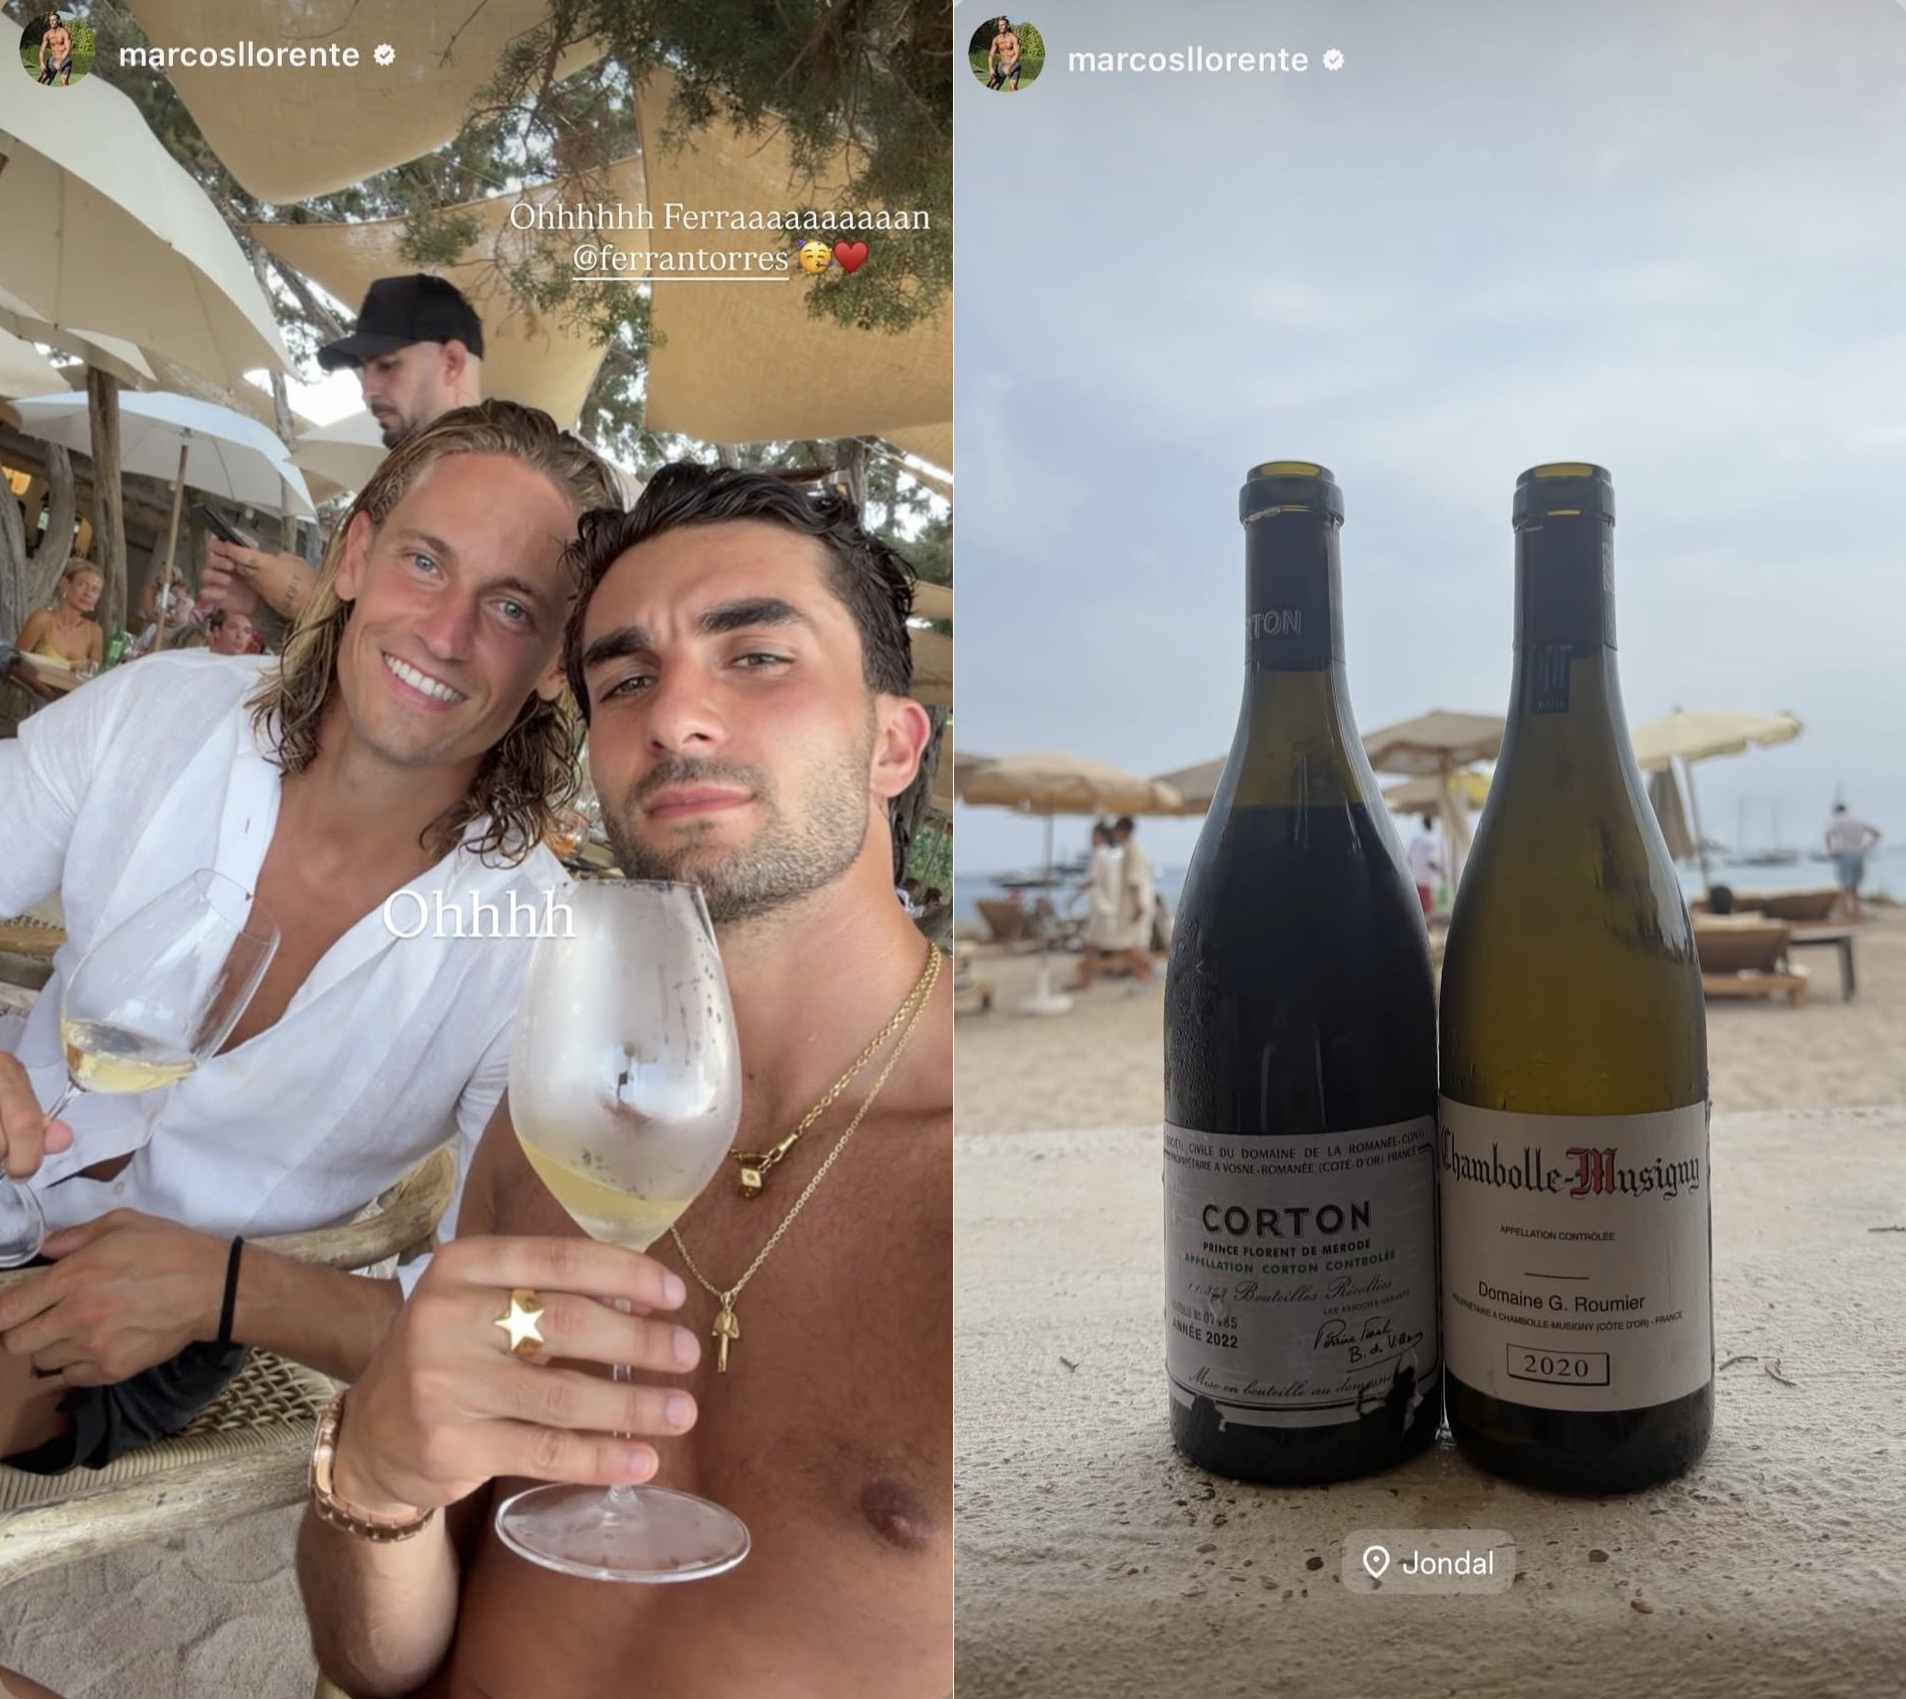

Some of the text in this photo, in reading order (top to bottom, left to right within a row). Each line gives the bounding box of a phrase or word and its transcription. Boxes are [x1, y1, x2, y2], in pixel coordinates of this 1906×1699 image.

[1188, 1143, 1214, 1156] CIVILE
[1219, 1147, 1235, 1158] DU
[1241, 1148, 1297, 1160] DOMAINE
[1304, 1147, 1319, 1158] DE
[1327, 1145, 1342, 1157] LA
[1222, 1162, 1315, 1174] VOSNE-ROMANÉE
[1387, 1147, 1417, 1163] FRANCE
[1441, 1125, 1700, 1201] Chambolle-Musigny
[1202, 1200, 1371, 1239] CORTON
[1500, 1225, 1615, 1242] APPELLATION CONTRÔLÉE
[1203, 1239, 1371, 1258] PRINCE FLORENT DE MERODE
[1185, 1252, 1253, 1273] APPELLATION
[1262, 1263, 1318, 1274] CORTON
[1233, 1280, 1317, 1303] Bouteilles
[1478, 1280, 1647, 1313] Domaine G. Roumier
[1323, 1306, 1339, 1315] LES
[1498, 1312, 1595, 1332] CHAMBOLLE-MUSIGNY
[1626, 1318, 1650, 1329] D'OR)
[1655, 1310, 1683, 1326] FRANCE
[1172, 1316, 1239, 1349] ANNÉE 2022
[1523, 1354, 1589, 1378] 2020
[1189, 1366, 1221, 1389] Mise
[1223, 1385, 1238, 1394] en
[1243, 1379, 1308, 1397] bouteille
[1311, 1387, 1332, 1395] au
